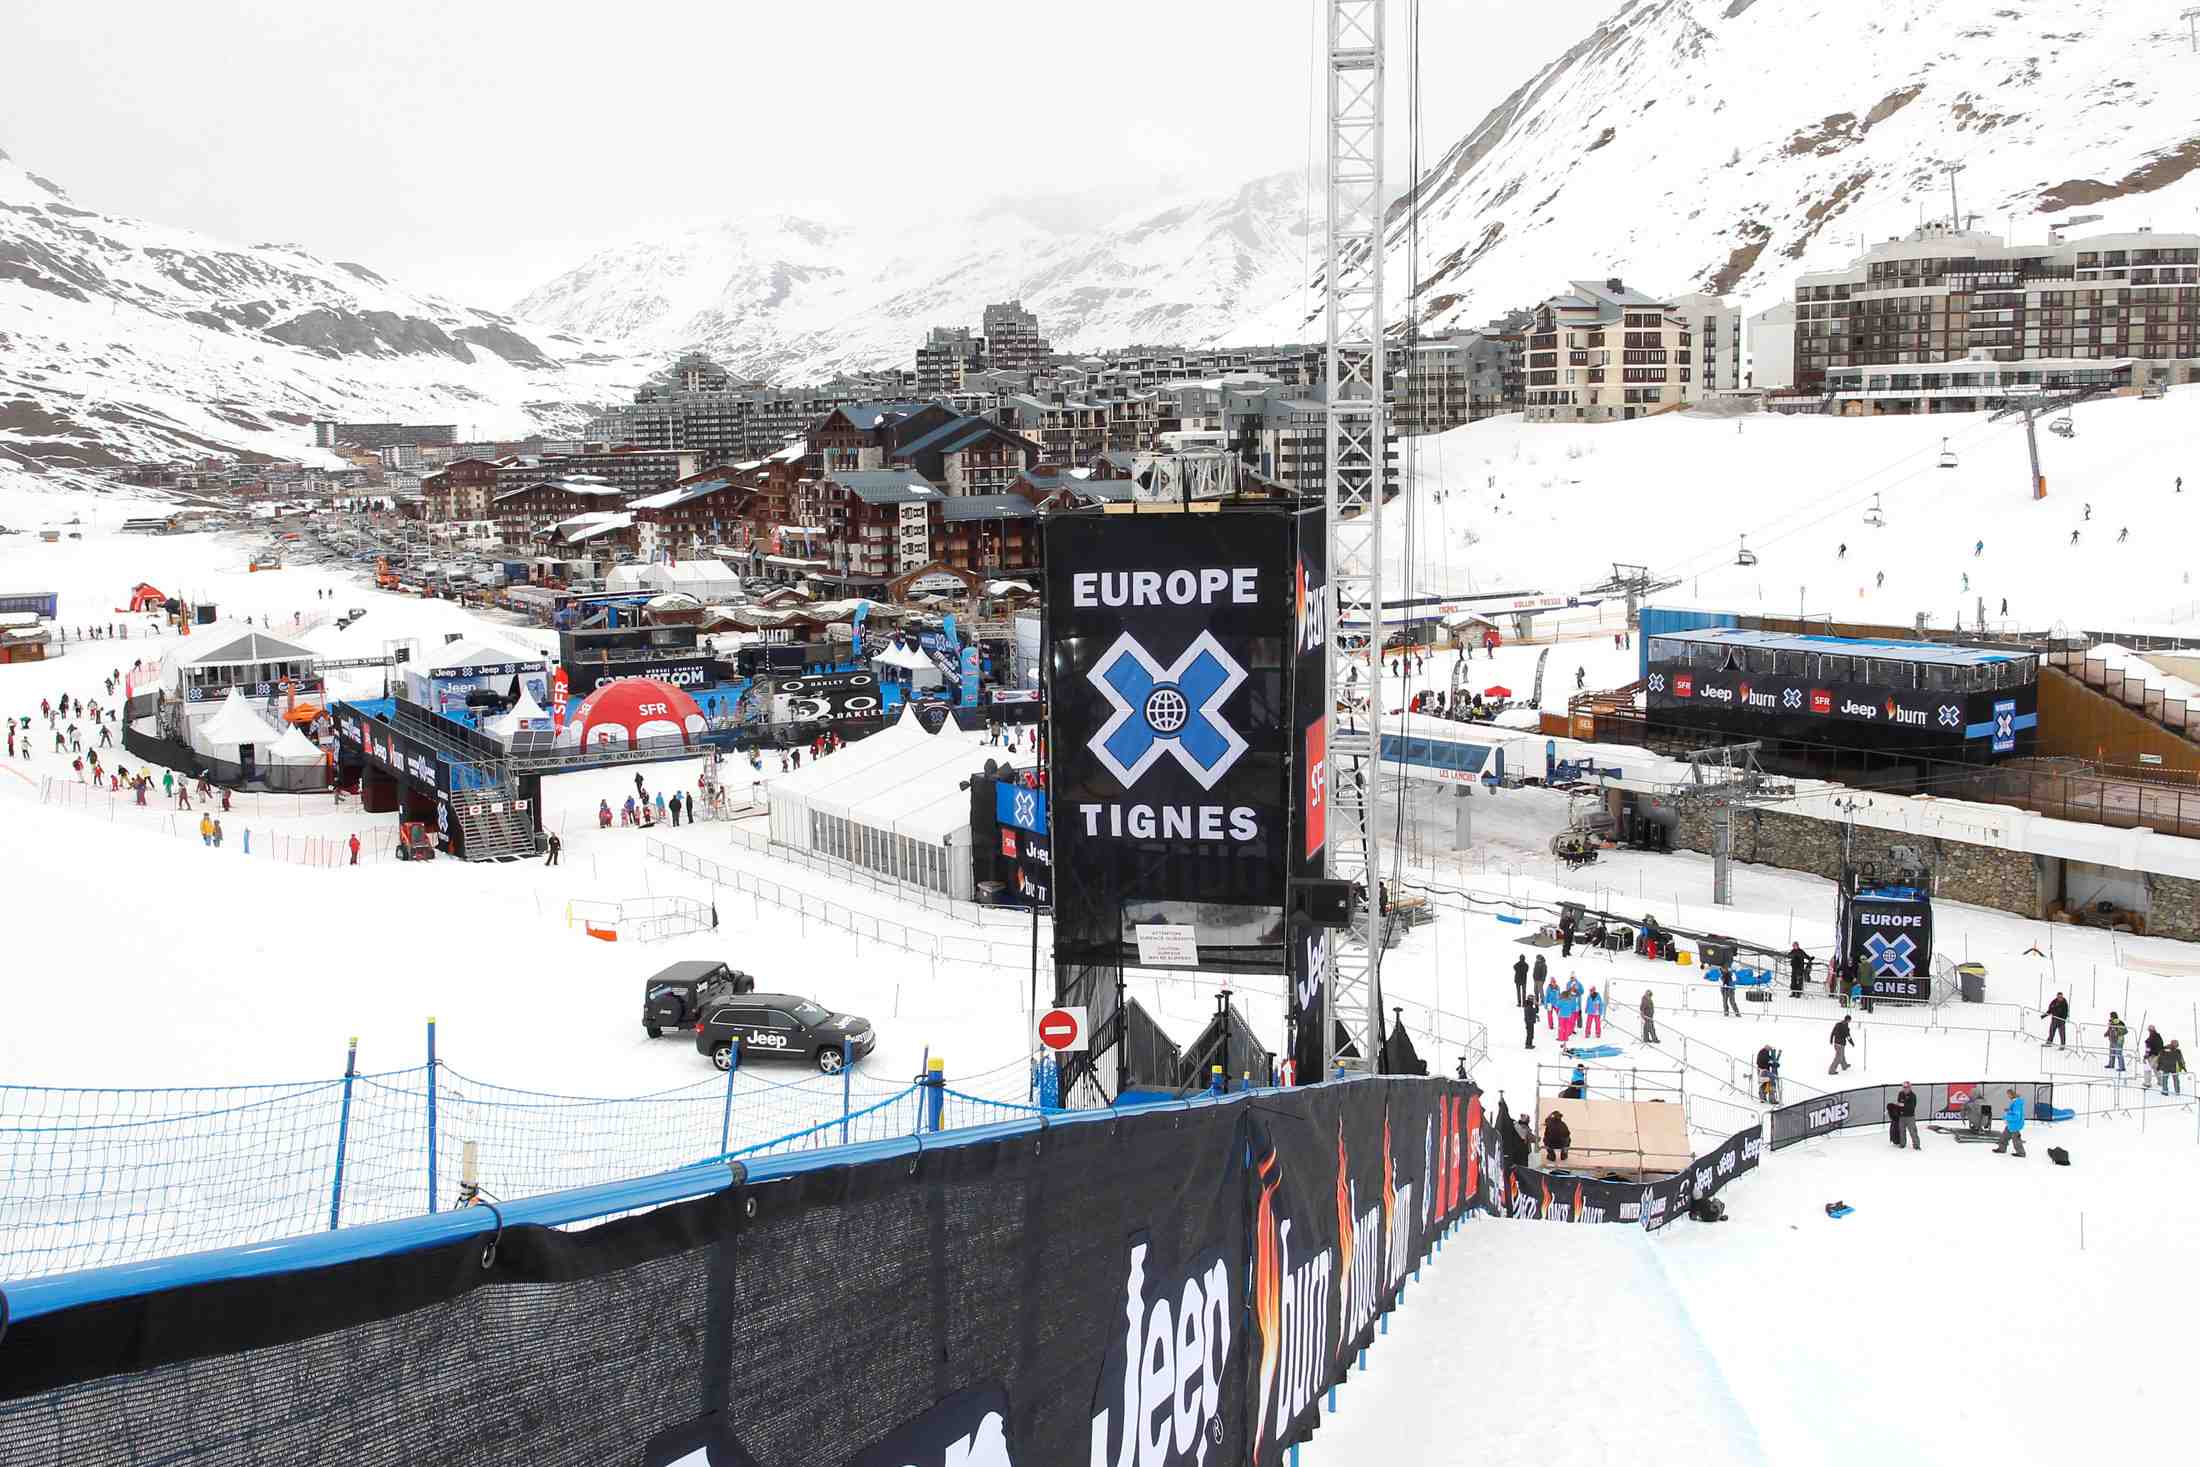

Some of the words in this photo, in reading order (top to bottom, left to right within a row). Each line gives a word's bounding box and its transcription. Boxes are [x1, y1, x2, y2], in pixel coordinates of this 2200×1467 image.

[1073, 568, 1259, 607] EUROPE
[479, 666, 499, 676] Jeep
[520, 663, 541, 673] Jeep
[811, 679, 844, 687] OAKLEY
[555, 682, 569, 715] SFR
[638, 702, 668, 716] SFR
[837, 708, 882, 719] OAKLEY
[1700, 684, 1732, 702] Jeep
[1749, 688, 1776, 707] burn
[1815, 696, 1831, 705] SFR
[1841, 700, 1877, 719] Jeep
[1897, 704, 1926, 725] burn
[1312, 759, 1327, 807] SF
[1080, 803, 1258, 841] TIGNES
[1861, 913, 1922, 927] EUROPE
[1299, 935, 1325, 1011] Jee
[1873, 981, 1917, 994] GNES
[747, 1030, 787, 1048] Jeep
[1809, 1102, 1849, 1129] TIGNES
[1717, 1150, 1736, 1177] Jeep
[1741, 1136, 1761, 1161] Jeep
[1348, 1179, 1380, 1346] burn
[1276, 1218, 1333, 1440] burn
[1091, 1243, 1230, 1467] Jeep
